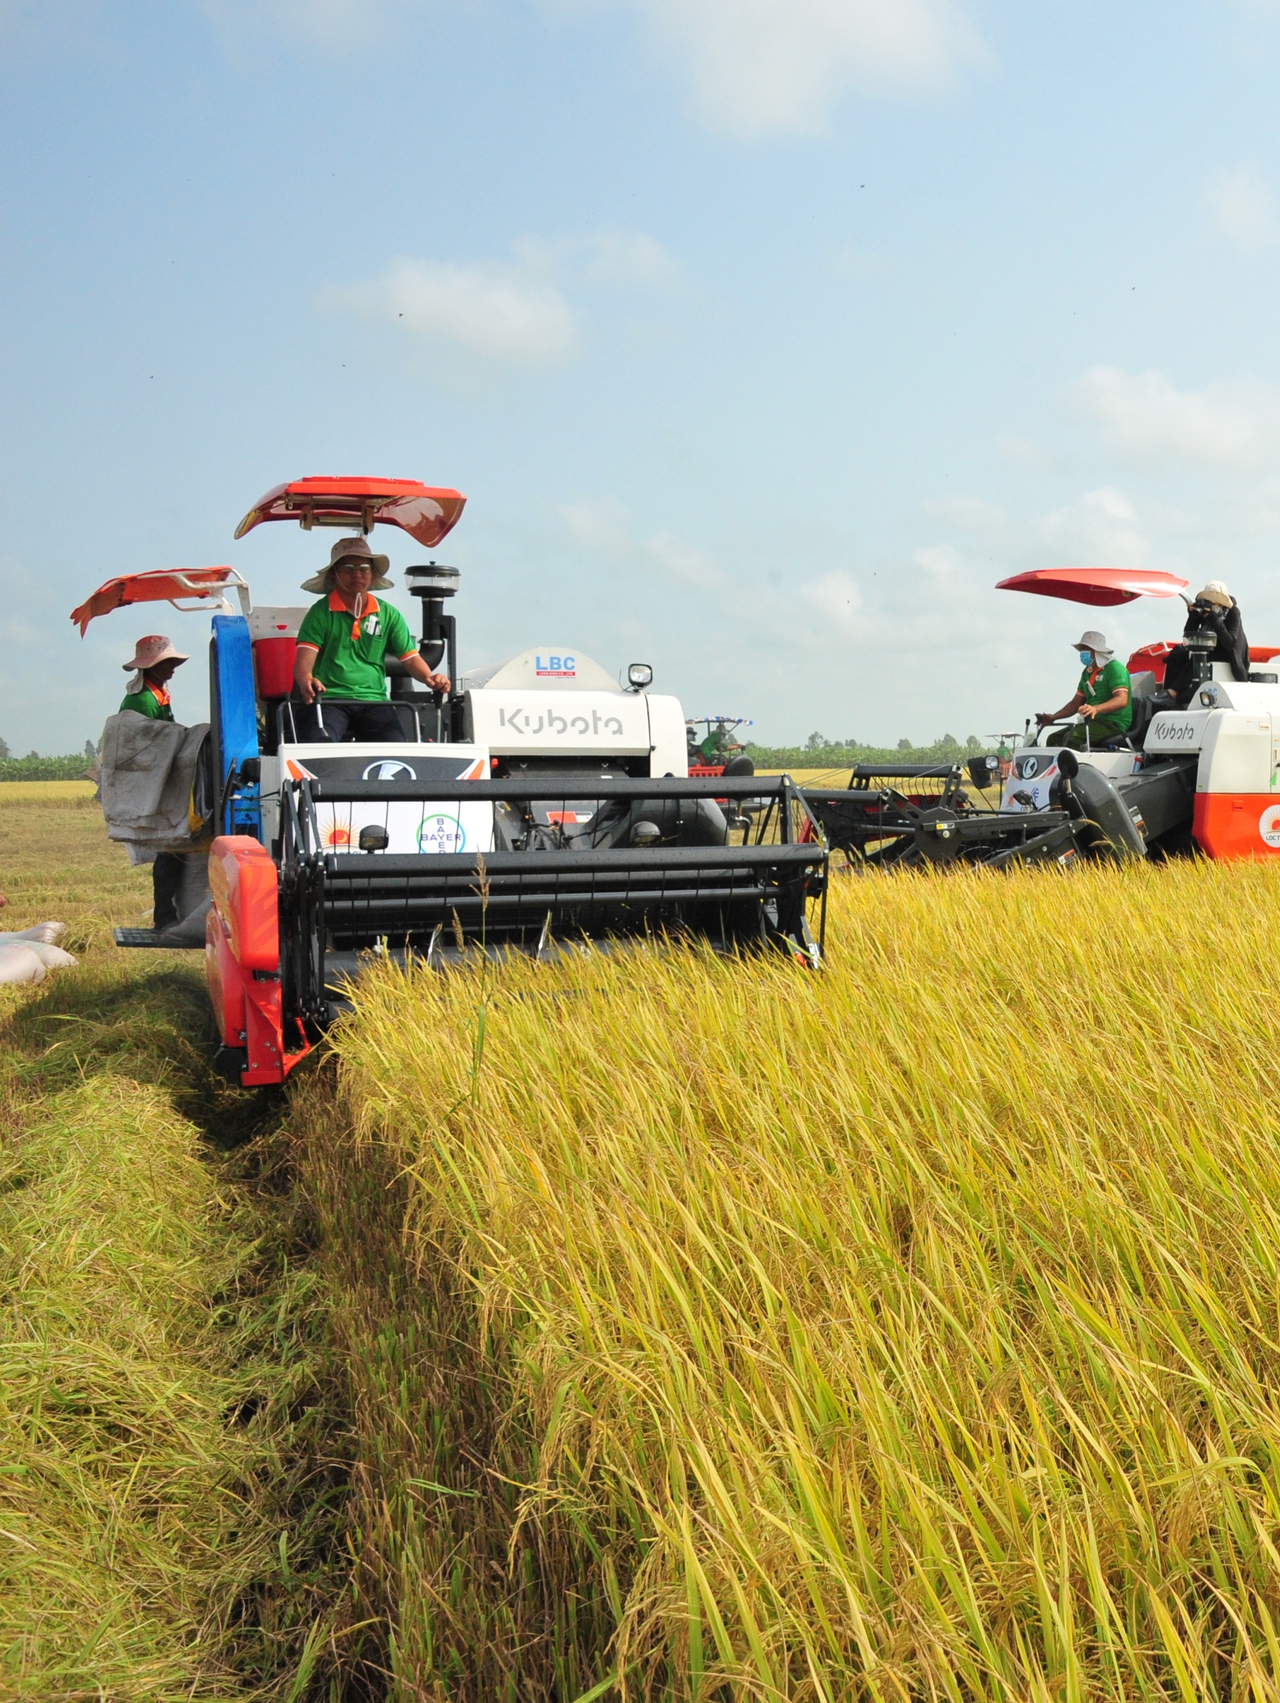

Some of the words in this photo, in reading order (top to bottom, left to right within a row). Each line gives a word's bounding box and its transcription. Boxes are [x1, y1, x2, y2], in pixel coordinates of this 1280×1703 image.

[535, 656, 576, 671] LBC
[499, 708, 623, 735] Kubota
[1154, 723, 1194, 740] Kubota
